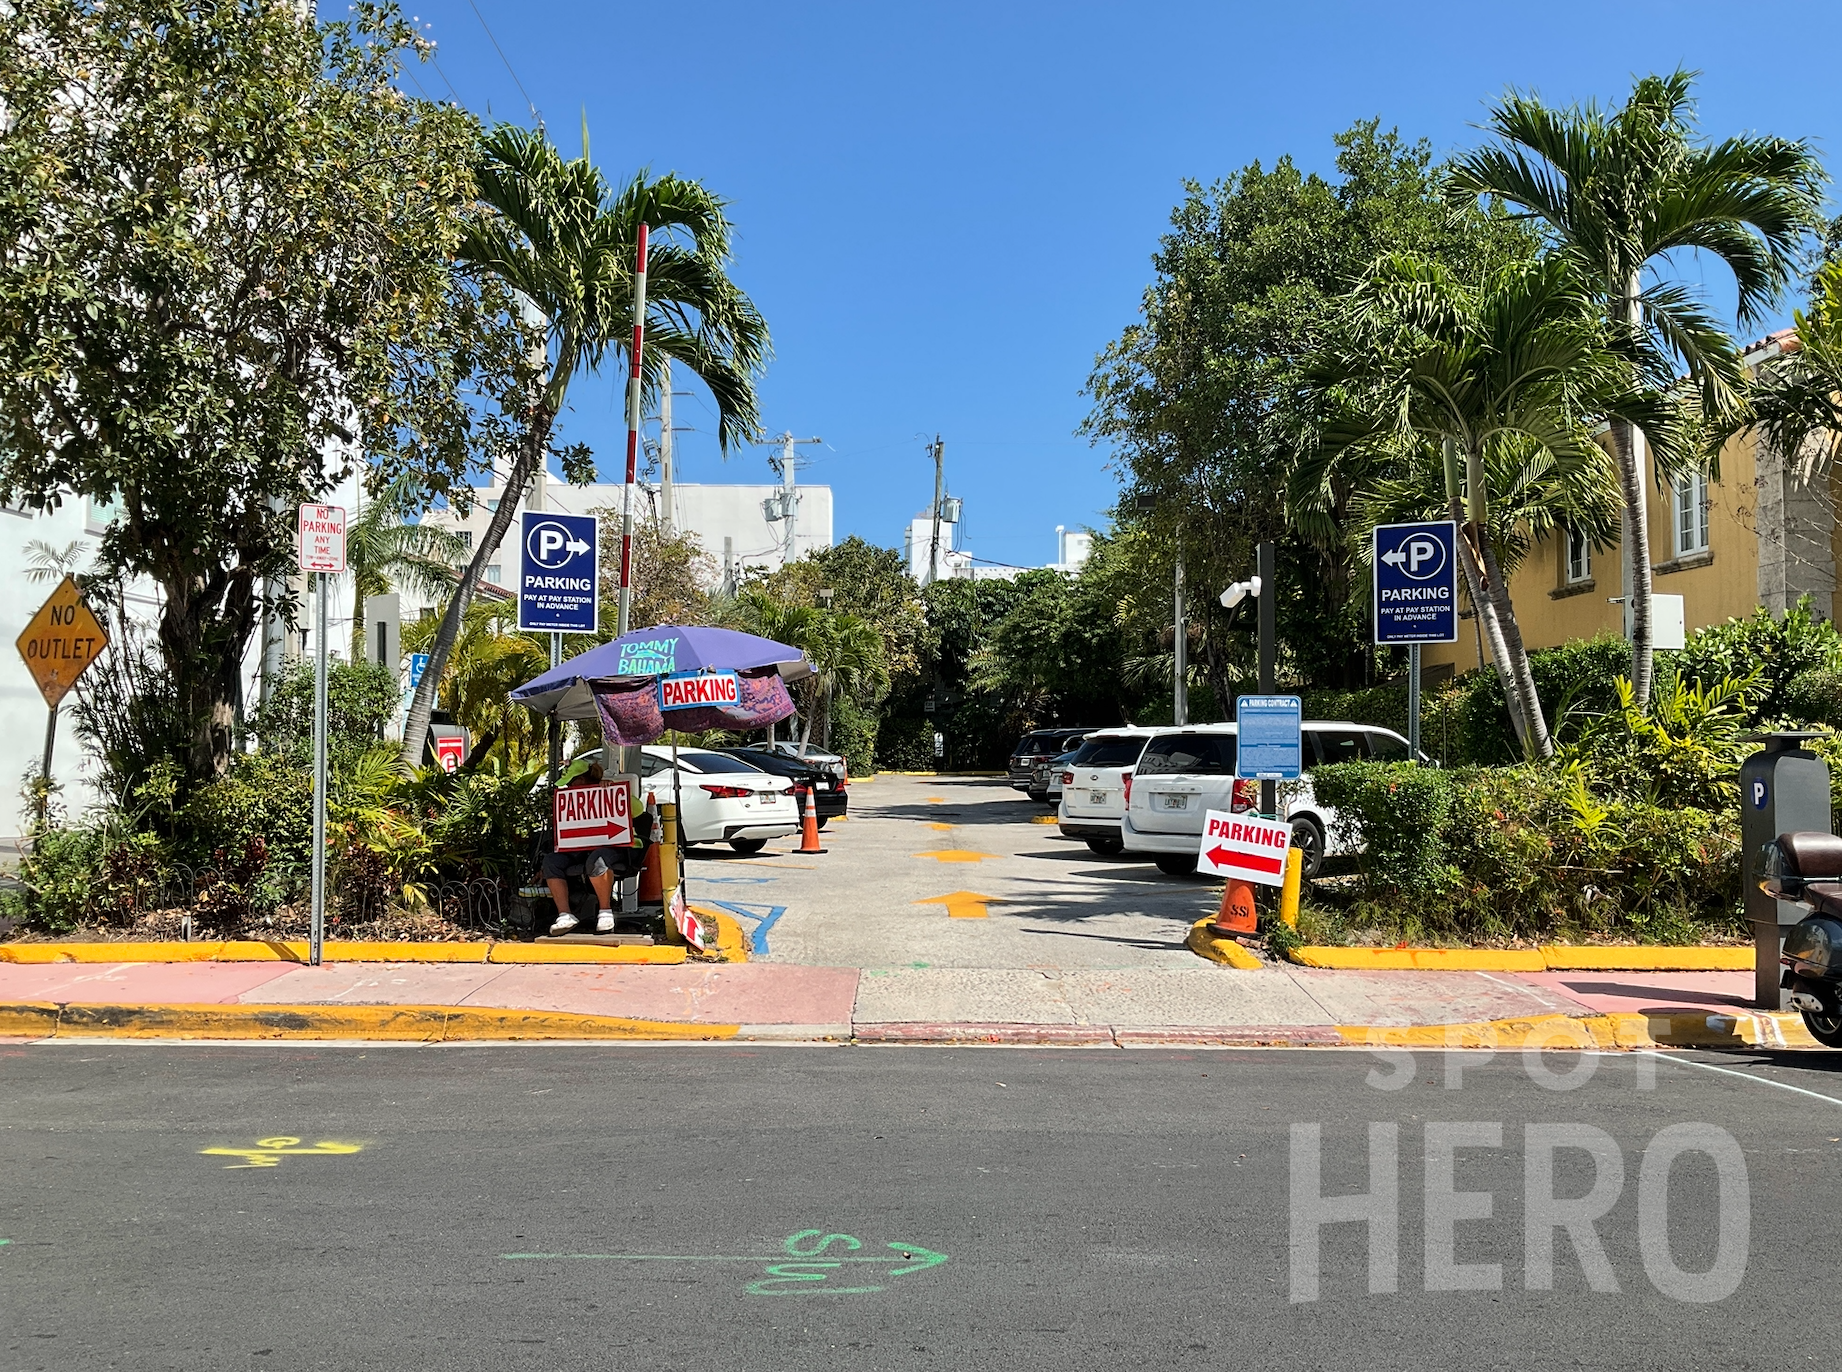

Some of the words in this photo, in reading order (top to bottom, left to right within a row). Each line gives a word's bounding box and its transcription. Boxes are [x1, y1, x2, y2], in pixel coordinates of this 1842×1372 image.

[317, 508, 329, 519] NO
[303, 520, 342, 534] PARKING
[314, 536, 330, 544] ANY
[539, 529, 564, 560] P
[314, 546, 331, 554] TIME
[1410, 541, 1434, 572] P
[525, 575, 592, 591] PARKING
[548, 595, 562, 603] PAY
[563, 596, 592, 604] STATION
[1381, 586, 1450, 602] PARKING
[50, 604, 75, 626] NO
[545, 603, 579, 611] ADVANCE
[1420, 605, 1451, 613] STATION
[1402, 613, 1437, 621] ADVANCE
[27, 637, 96, 660] OUTLET
[620, 637, 679, 657] TOMMY
[617, 654, 676, 675] BAHAMA
[662, 678, 737, 706] PARKING
[1753, 781, 1765, 805] P
[557, 787, 628, 823] PARKING
[1208, 818, 1287, 849] PARKING
